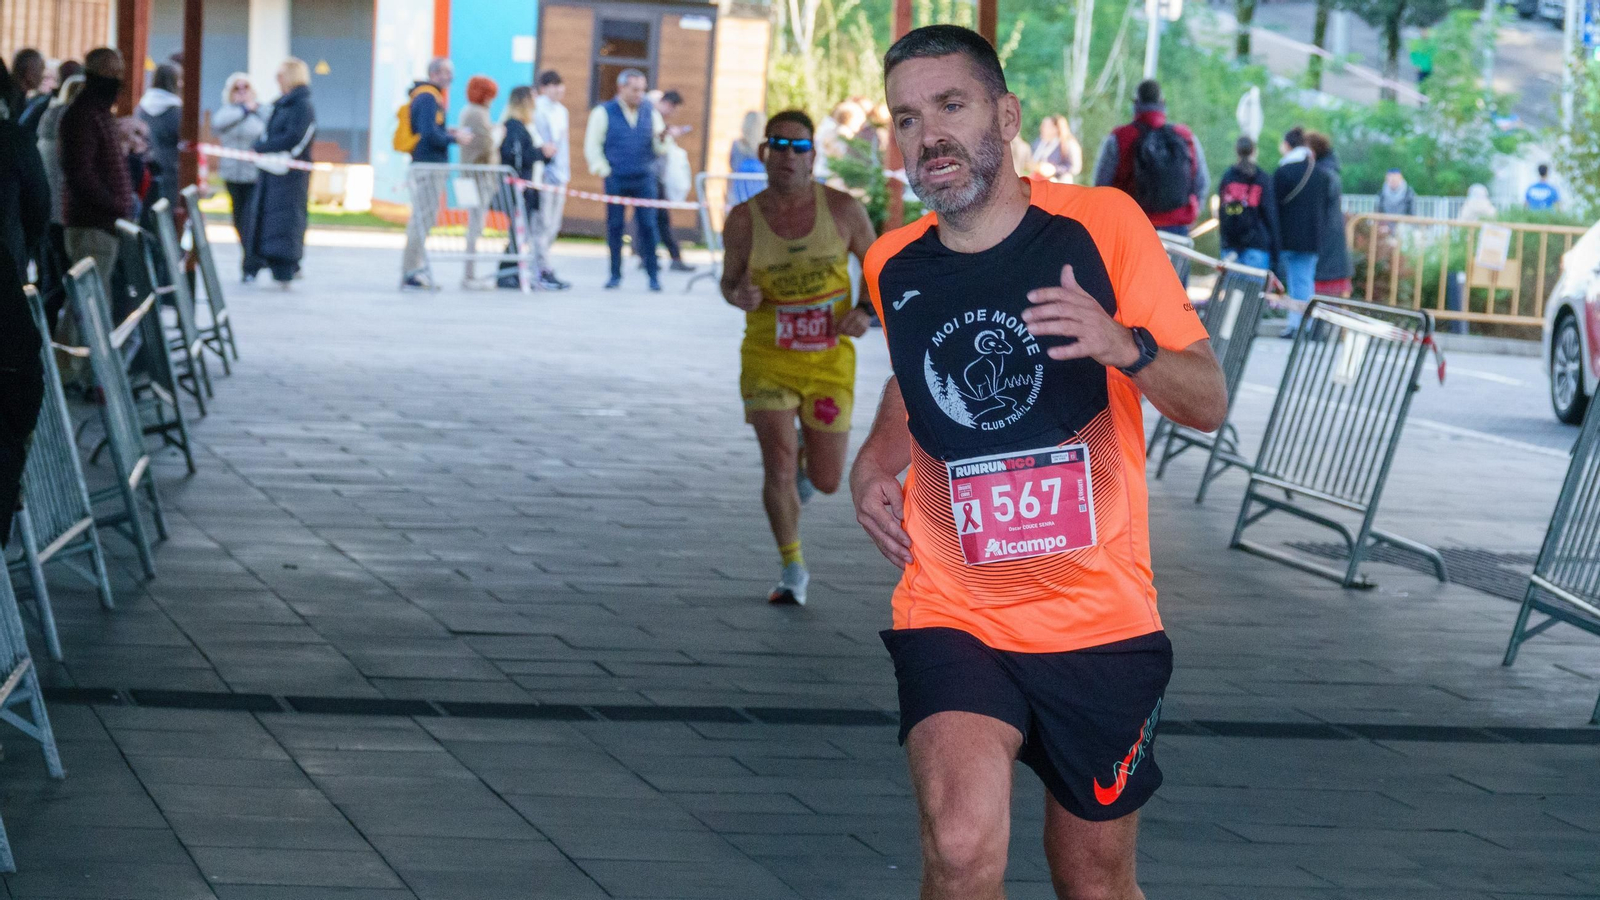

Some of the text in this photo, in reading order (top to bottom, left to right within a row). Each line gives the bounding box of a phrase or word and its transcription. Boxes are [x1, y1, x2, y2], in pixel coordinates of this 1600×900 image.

[932, 309, 1041, 356] MOI DE MONTE
[981, 363, 1044, 431] CLUB TRAIL RUNNING
[991, 477, 1062, 522] 567
[984, 535, 1067, 558] Alcampo
